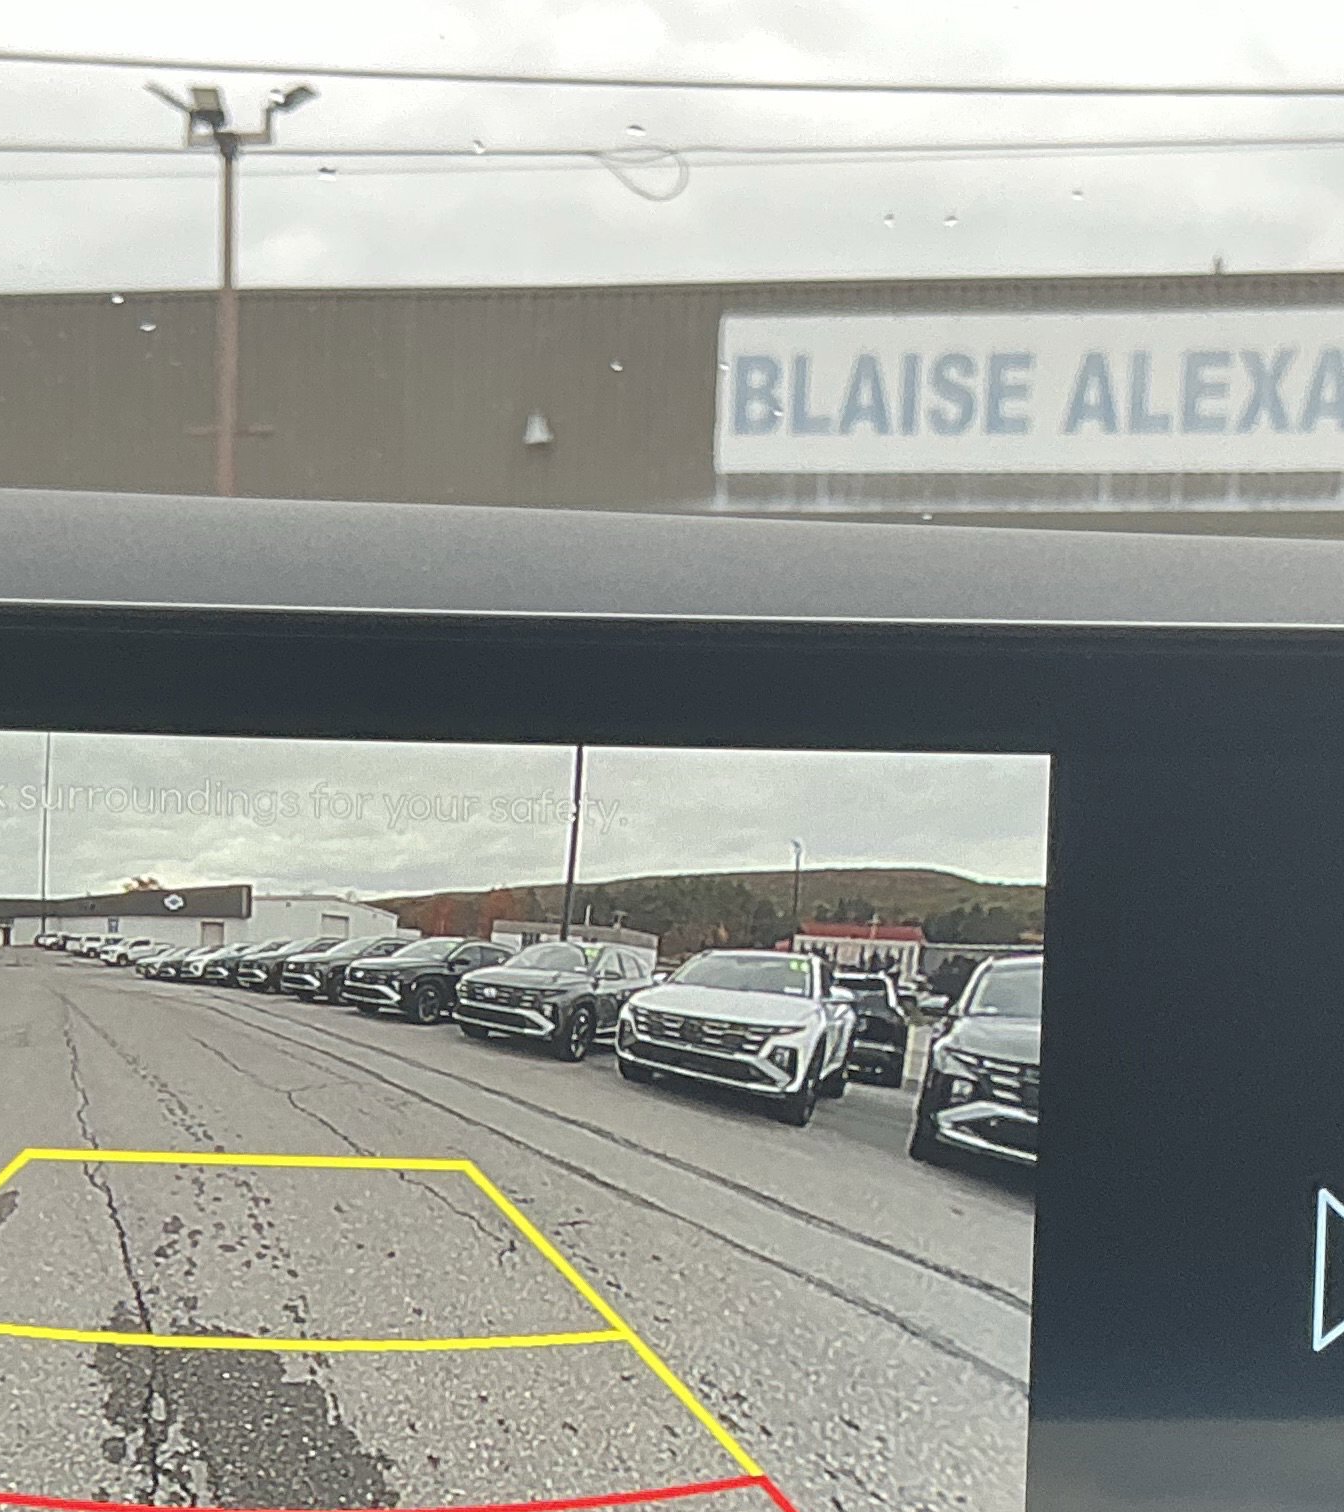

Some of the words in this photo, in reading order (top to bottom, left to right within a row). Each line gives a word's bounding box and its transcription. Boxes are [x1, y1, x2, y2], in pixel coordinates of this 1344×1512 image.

[732, 350, 1036, 437] BLAISE
[18, 778, 301, 826] surroundings
[308, 781, 374, 820] for
[383, 795, 482, 829] your
[489, 788, 630, 833] safety.
